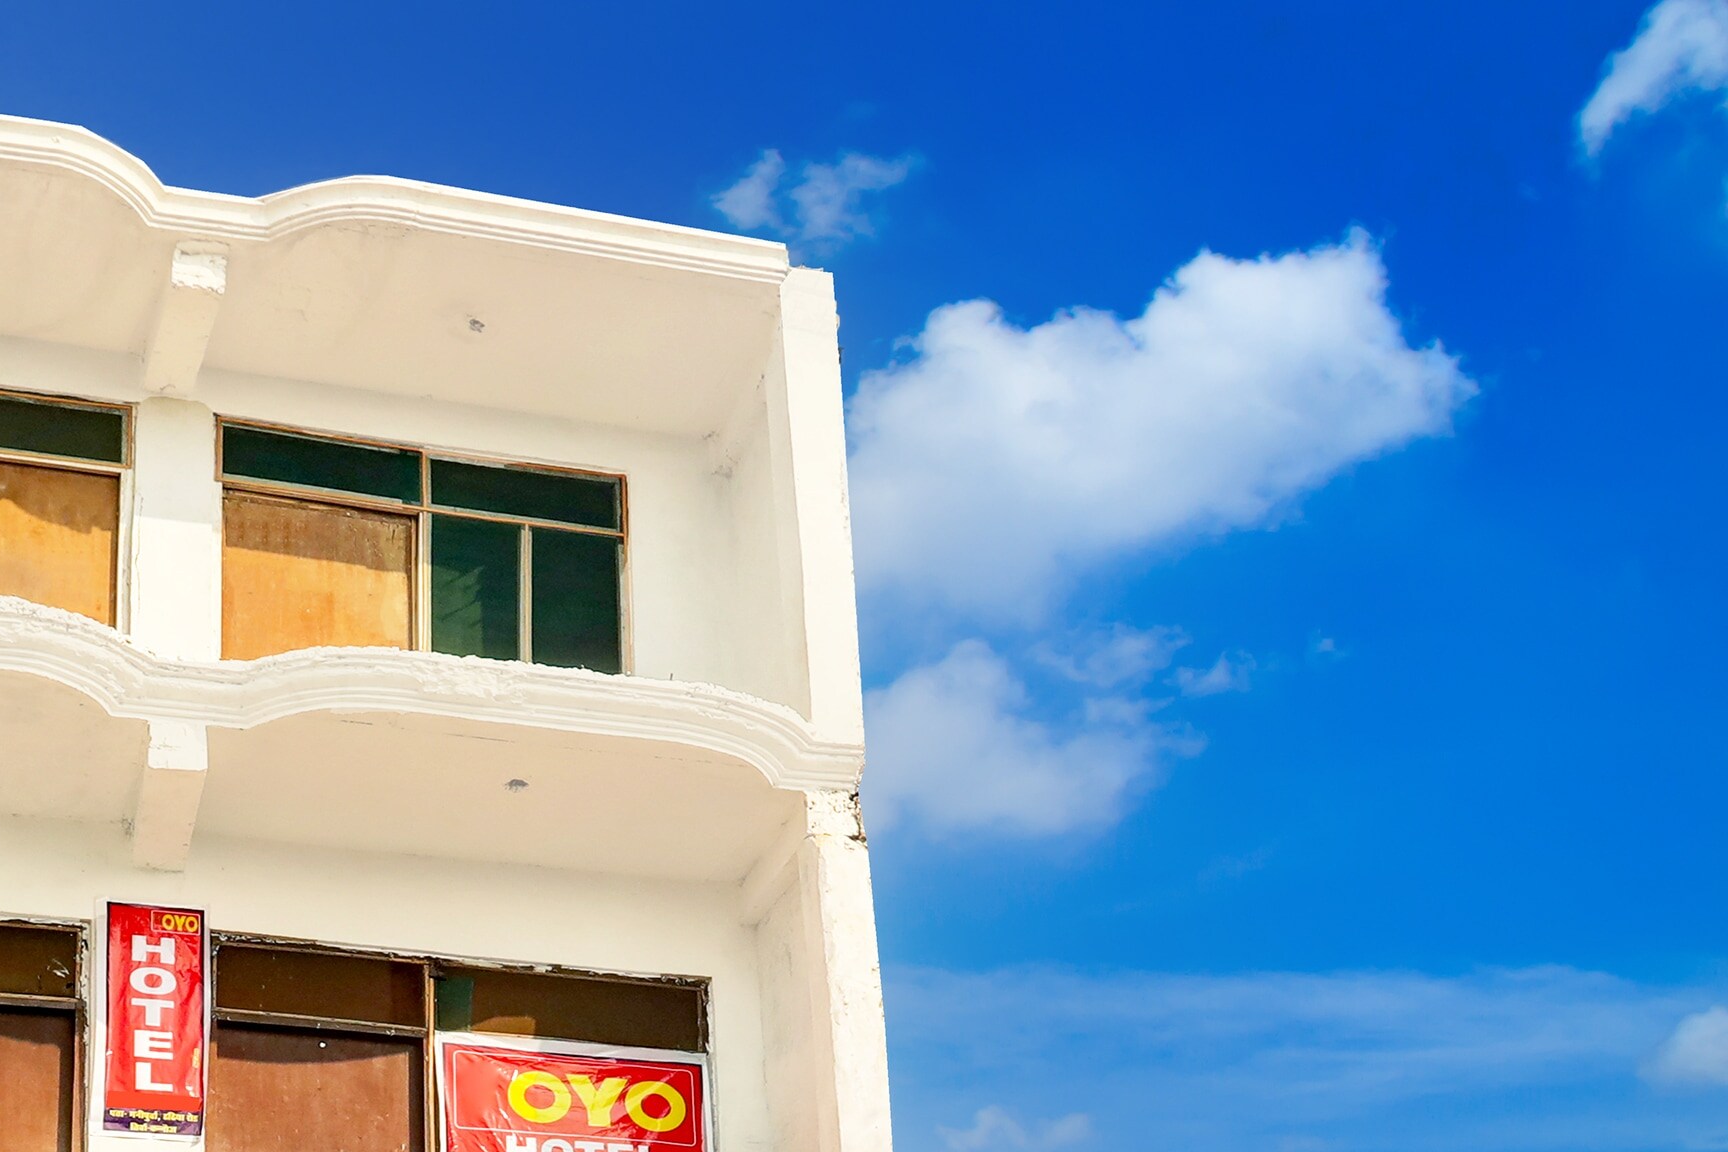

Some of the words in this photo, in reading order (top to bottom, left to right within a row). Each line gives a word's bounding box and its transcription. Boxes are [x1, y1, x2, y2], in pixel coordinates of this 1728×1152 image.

[162, 914, 198, 932] OYO
[129, 934, 177, 1092] HOTEL
[508, 1070, 686, 1132] OYO
